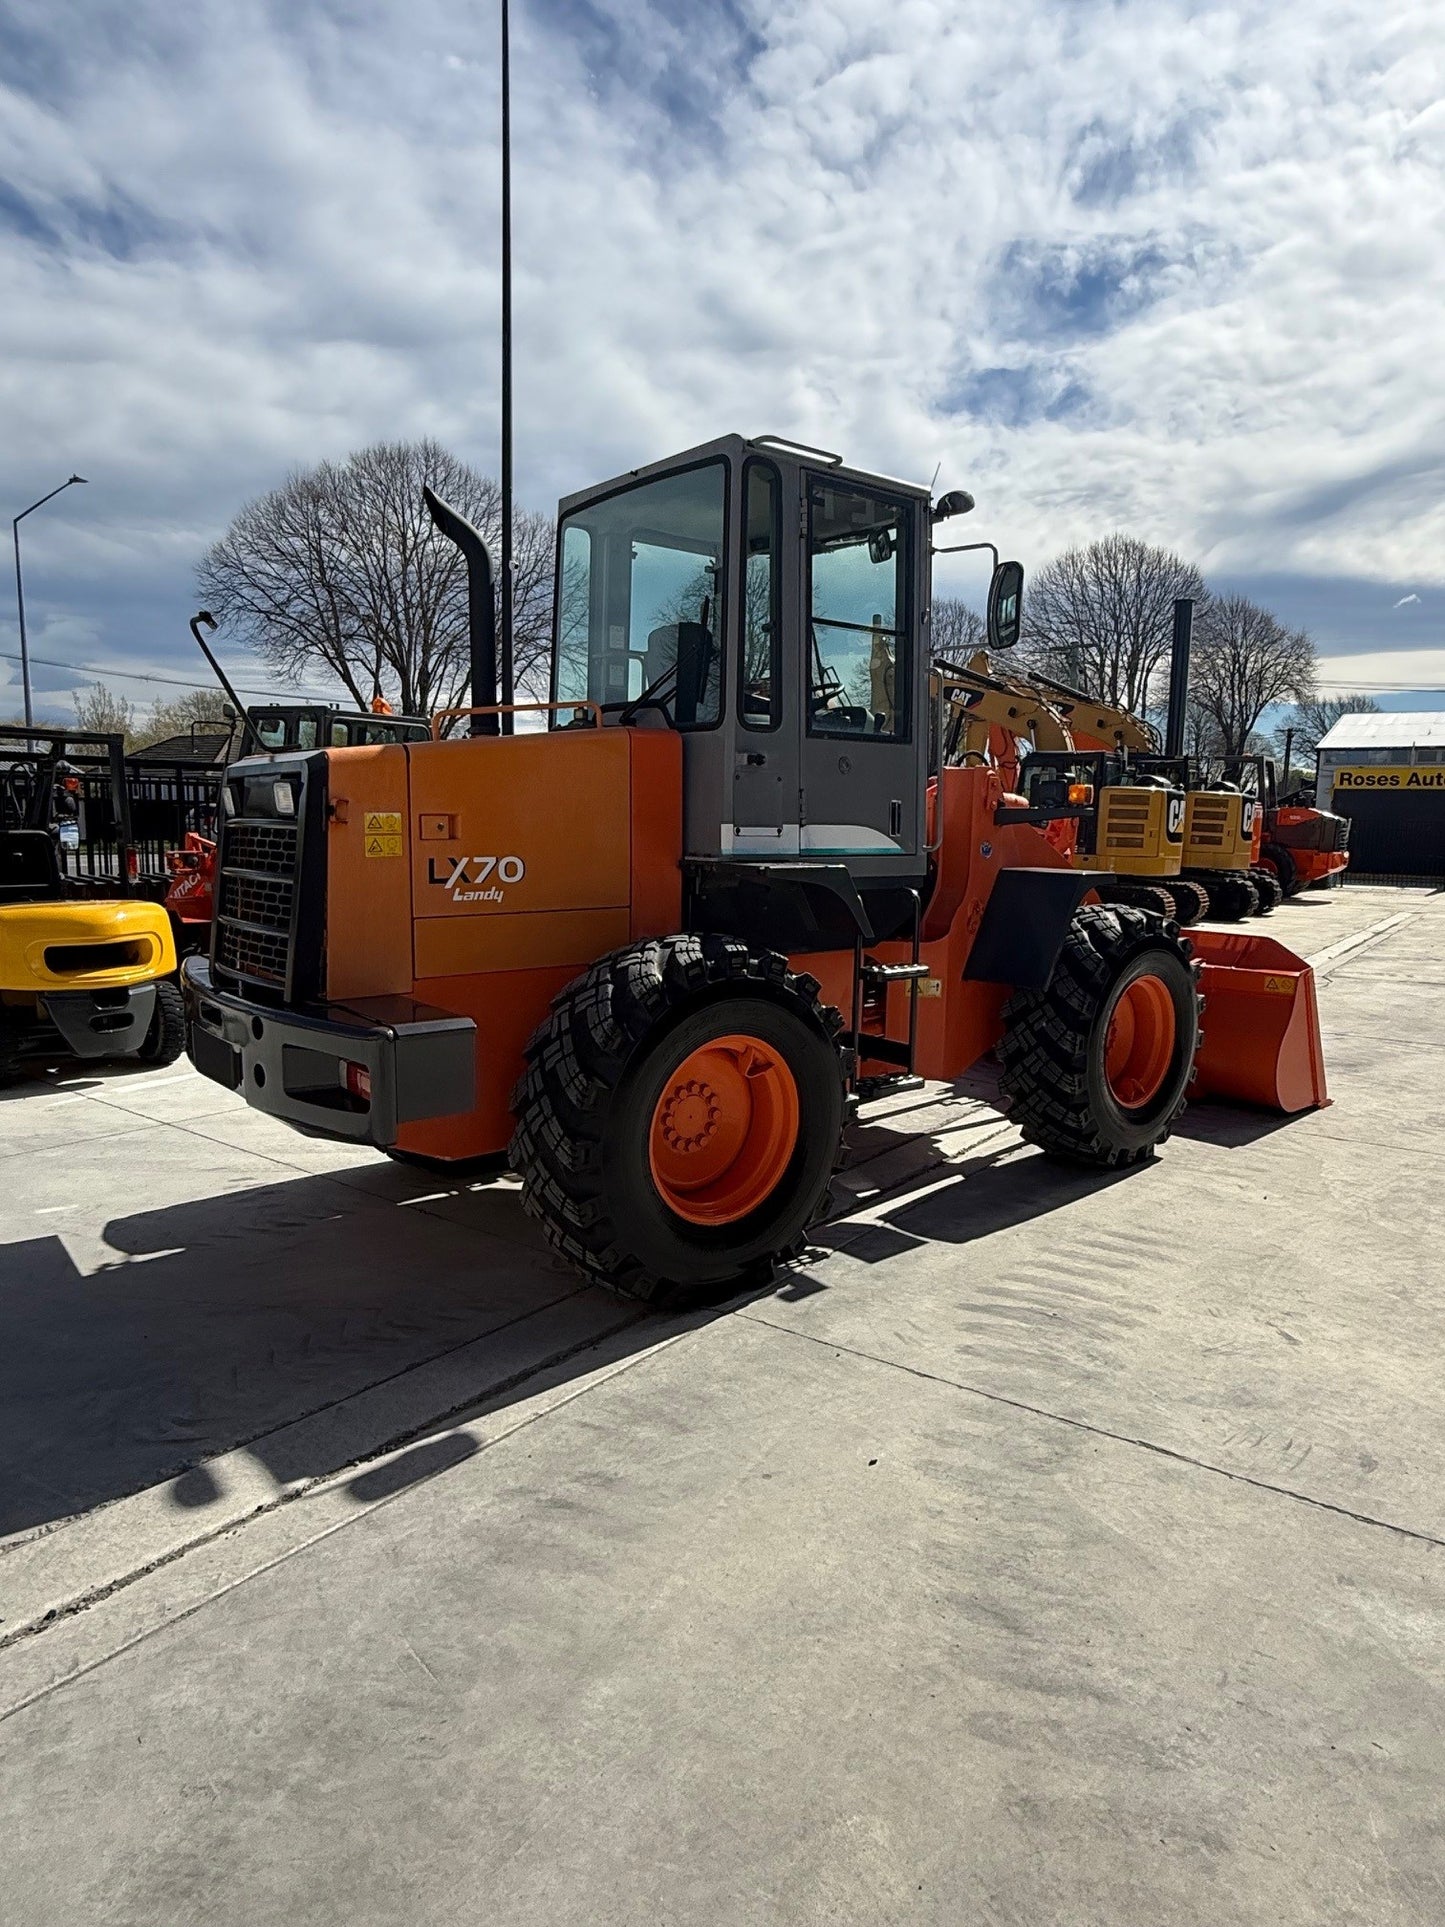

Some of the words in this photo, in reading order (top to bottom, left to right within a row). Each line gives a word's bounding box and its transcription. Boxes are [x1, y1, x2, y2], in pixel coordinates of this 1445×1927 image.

[950, 688, 972, 707] CAT
[1339, 772, 1400, 787] Roses
[1406, 772, 1445, 787] Aut
[1168, 799, 1186, 833] CA
[428, 855, 525, 890] LX70
[452, 886, 504, 903] Landy
